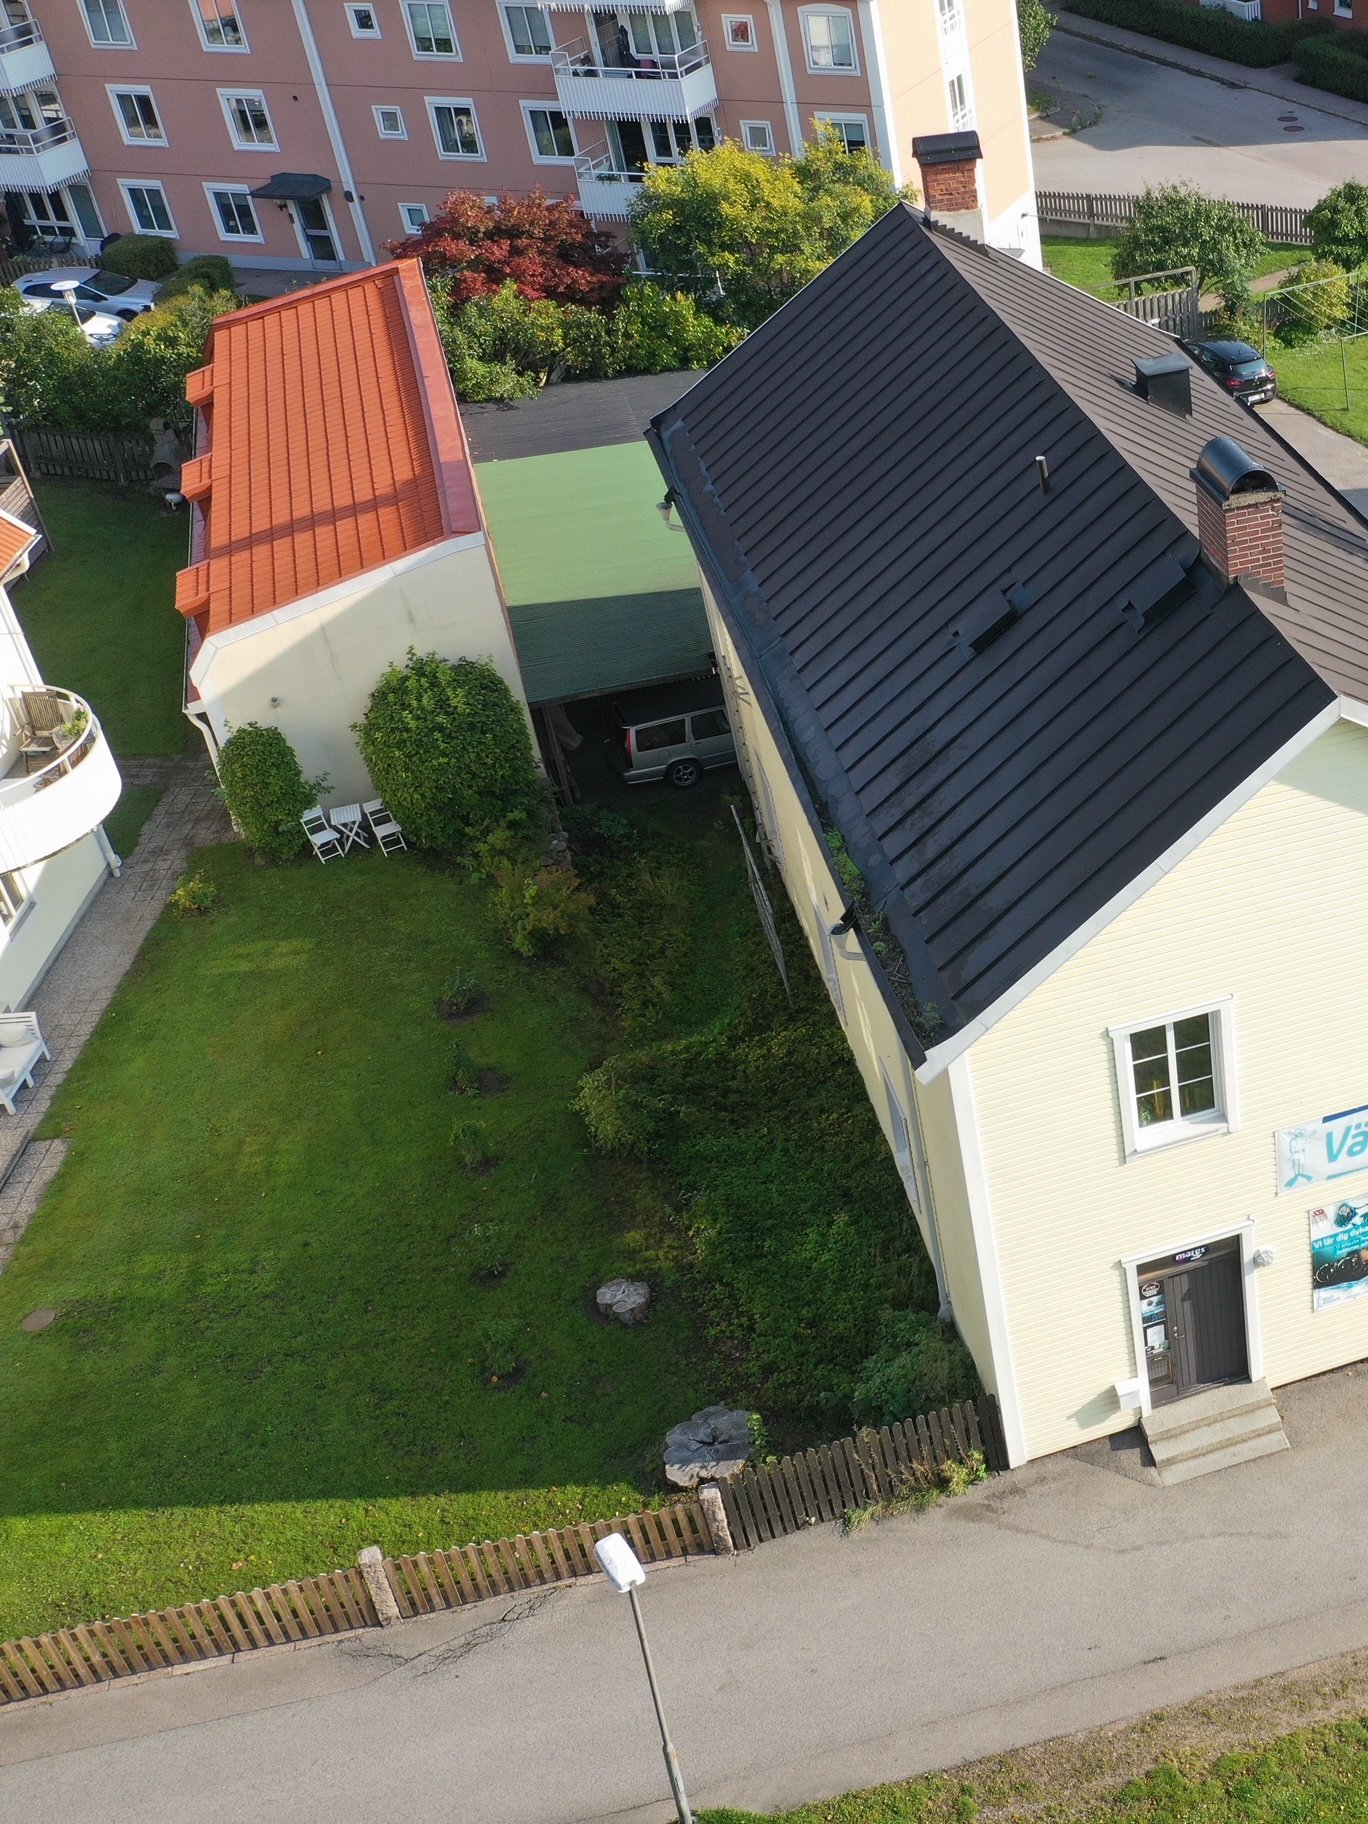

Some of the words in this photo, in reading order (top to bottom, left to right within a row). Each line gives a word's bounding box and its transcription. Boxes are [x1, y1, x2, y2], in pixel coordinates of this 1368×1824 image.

[1323, 1236, 1335, 1246] lär
[1336, 1231, 1349, 1242] dig
[1175, 1246, 1206, 1261] mares
